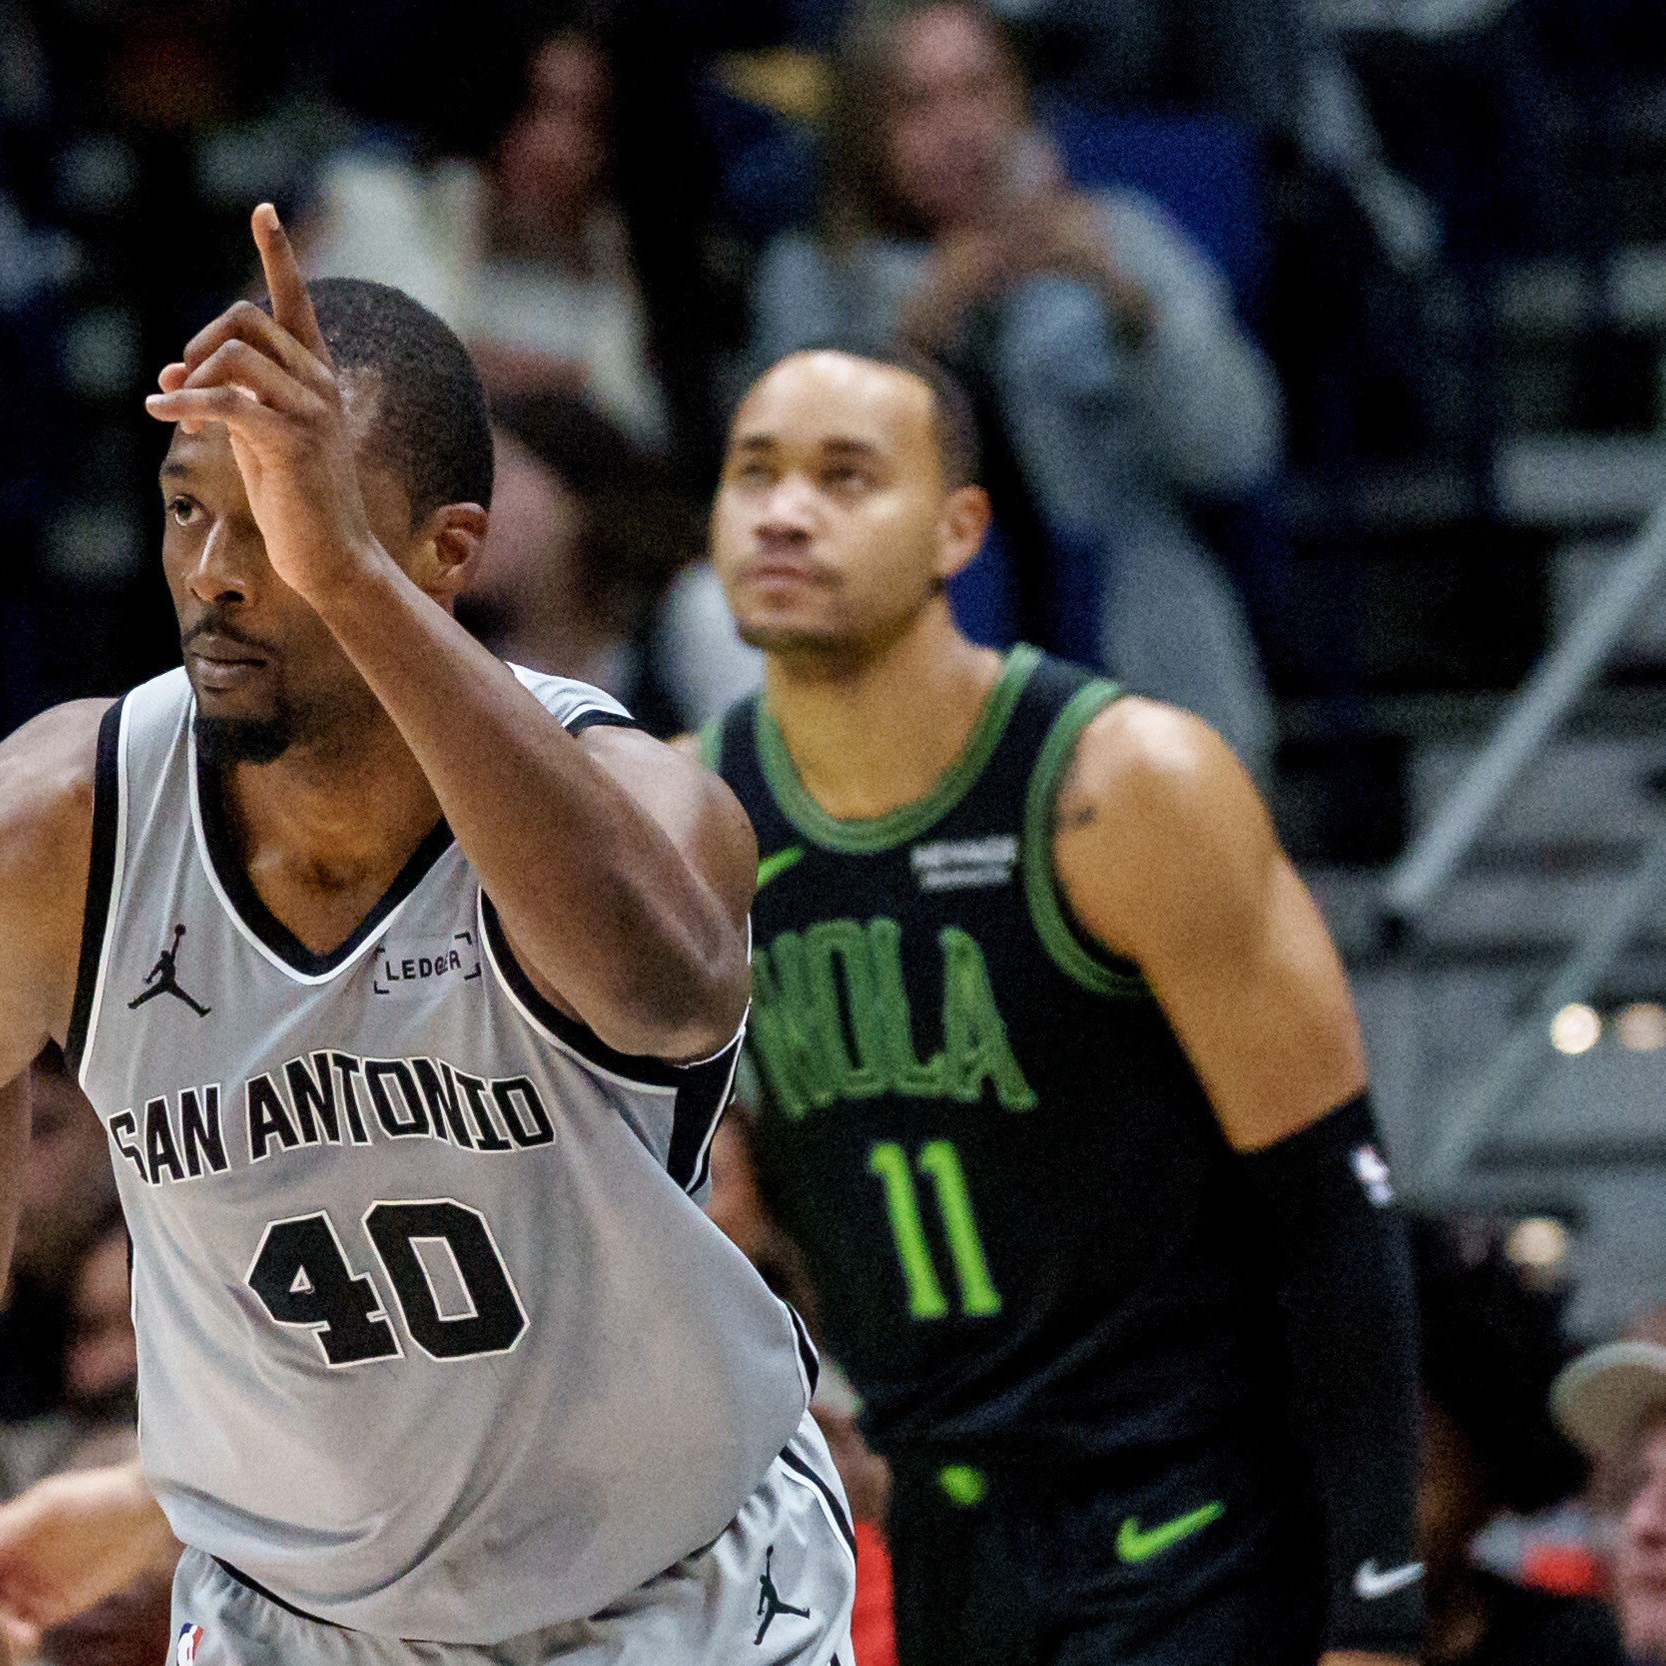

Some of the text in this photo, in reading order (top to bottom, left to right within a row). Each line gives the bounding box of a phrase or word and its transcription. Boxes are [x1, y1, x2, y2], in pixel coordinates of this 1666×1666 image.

[385, 949, 462, 981] LEDGR
[107, 1049, 556, 1187] SAN ANTONIO
[245, 1196, 531, 1369] 40
[869, 1140, 1002, 1320] 11
